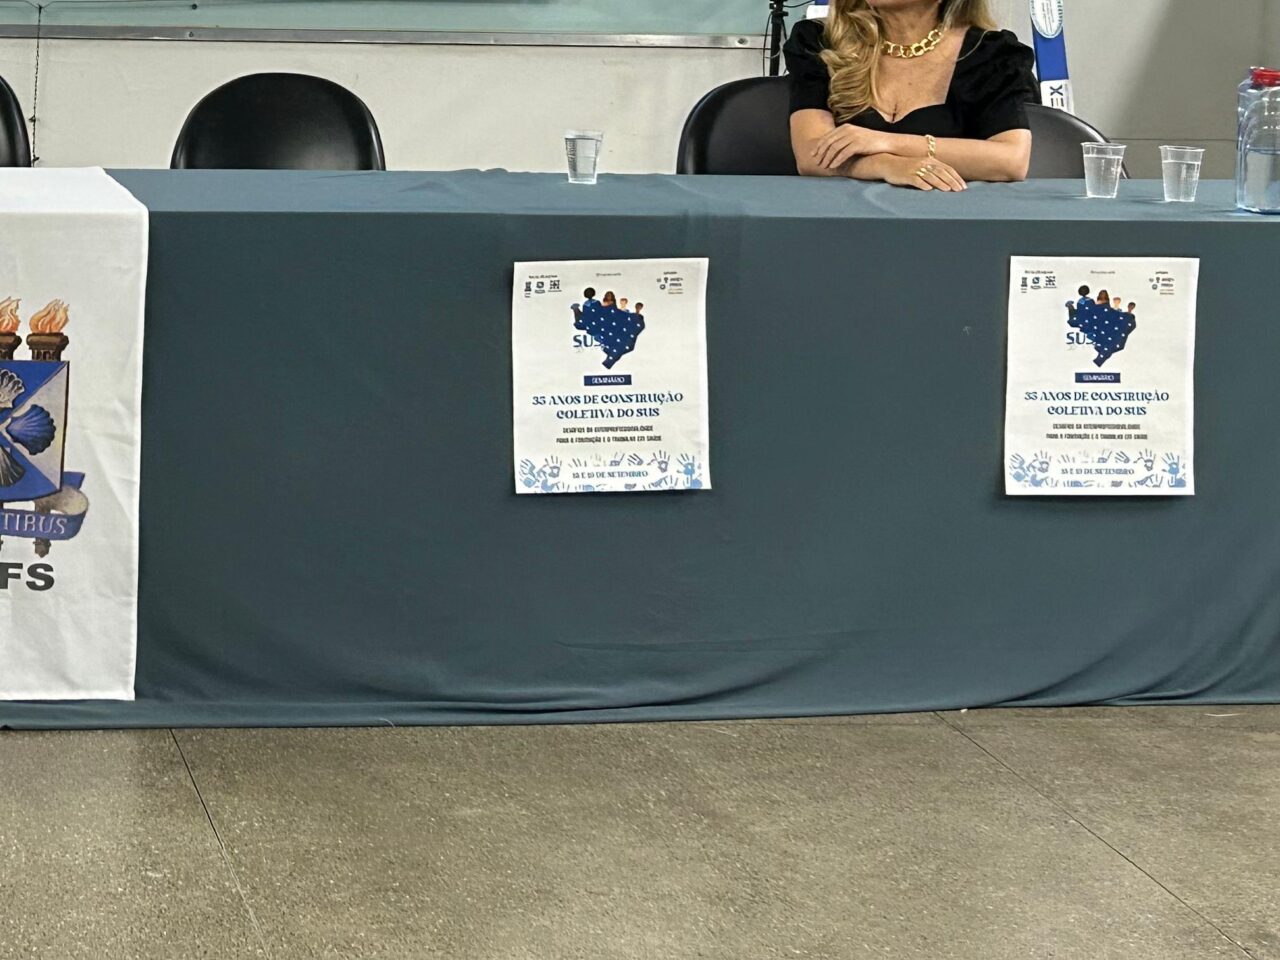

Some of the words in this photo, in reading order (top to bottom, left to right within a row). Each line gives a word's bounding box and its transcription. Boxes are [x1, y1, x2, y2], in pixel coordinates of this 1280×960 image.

[548, 394, 582, 405] ANOS
[583, 394, 599, 404] DE
[600, 391, 684, 406] CONSTRUÇÃO
[1039, 391, 1072, 401] ANOS
[1073, 391, 1089, 402] DE
[1090, 389, 1170, 404] CONSTRUÇÃO
[556, 408, 615, 419] COLETIVA
[617, 408, 635, 418] DO
[636, 407, 660, 418] SUS
[1047, 405, 1104, 416] COLETIVA
[1106, 406, 1123, 416] DO
[1124, 406, 1147, 416] SUS
